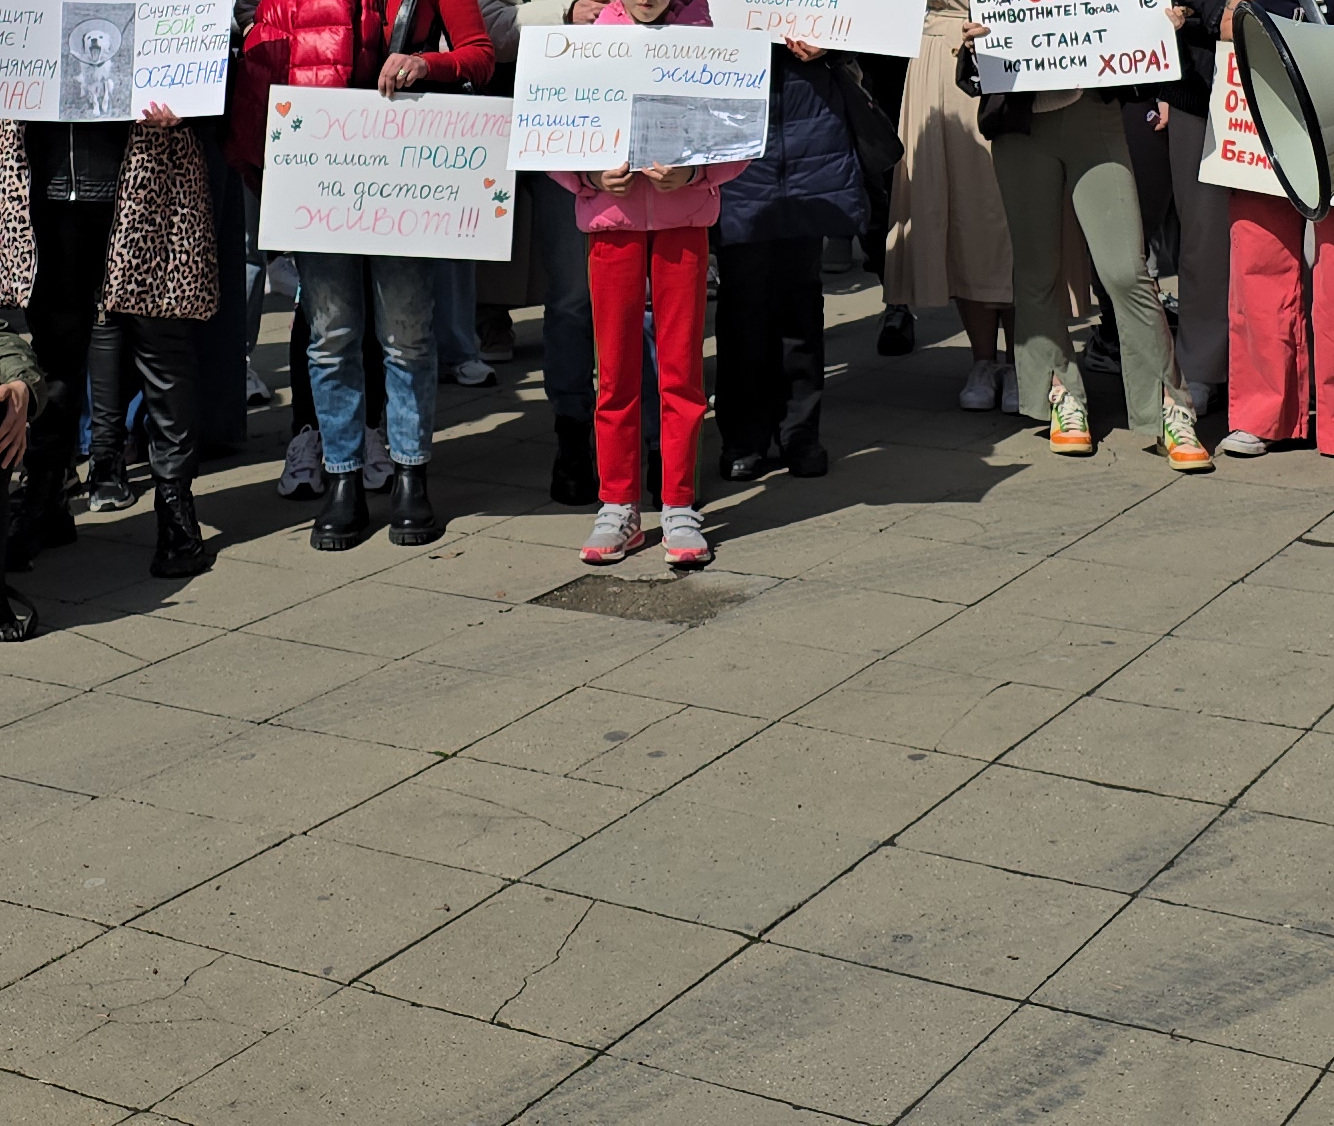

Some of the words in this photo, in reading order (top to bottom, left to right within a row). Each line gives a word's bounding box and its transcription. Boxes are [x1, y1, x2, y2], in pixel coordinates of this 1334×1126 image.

[155, 15, 195, 36] БОЙ
[1031, 29, 1108, 49] СТАНАТ
[607, 41, 632, 58] са
[644, 42, 740, 63] нашите
[1098, 40, 1170, 77] ХОРА!
[604, 87, 628, 102] са
[517, 114, 602, 128] нашите
[324, 153, 390, 167] имат
[400, 145, 487, 171] ПРАВО
[318, 180, 345, 197] на
[353, 181, 460, 211] достоен
